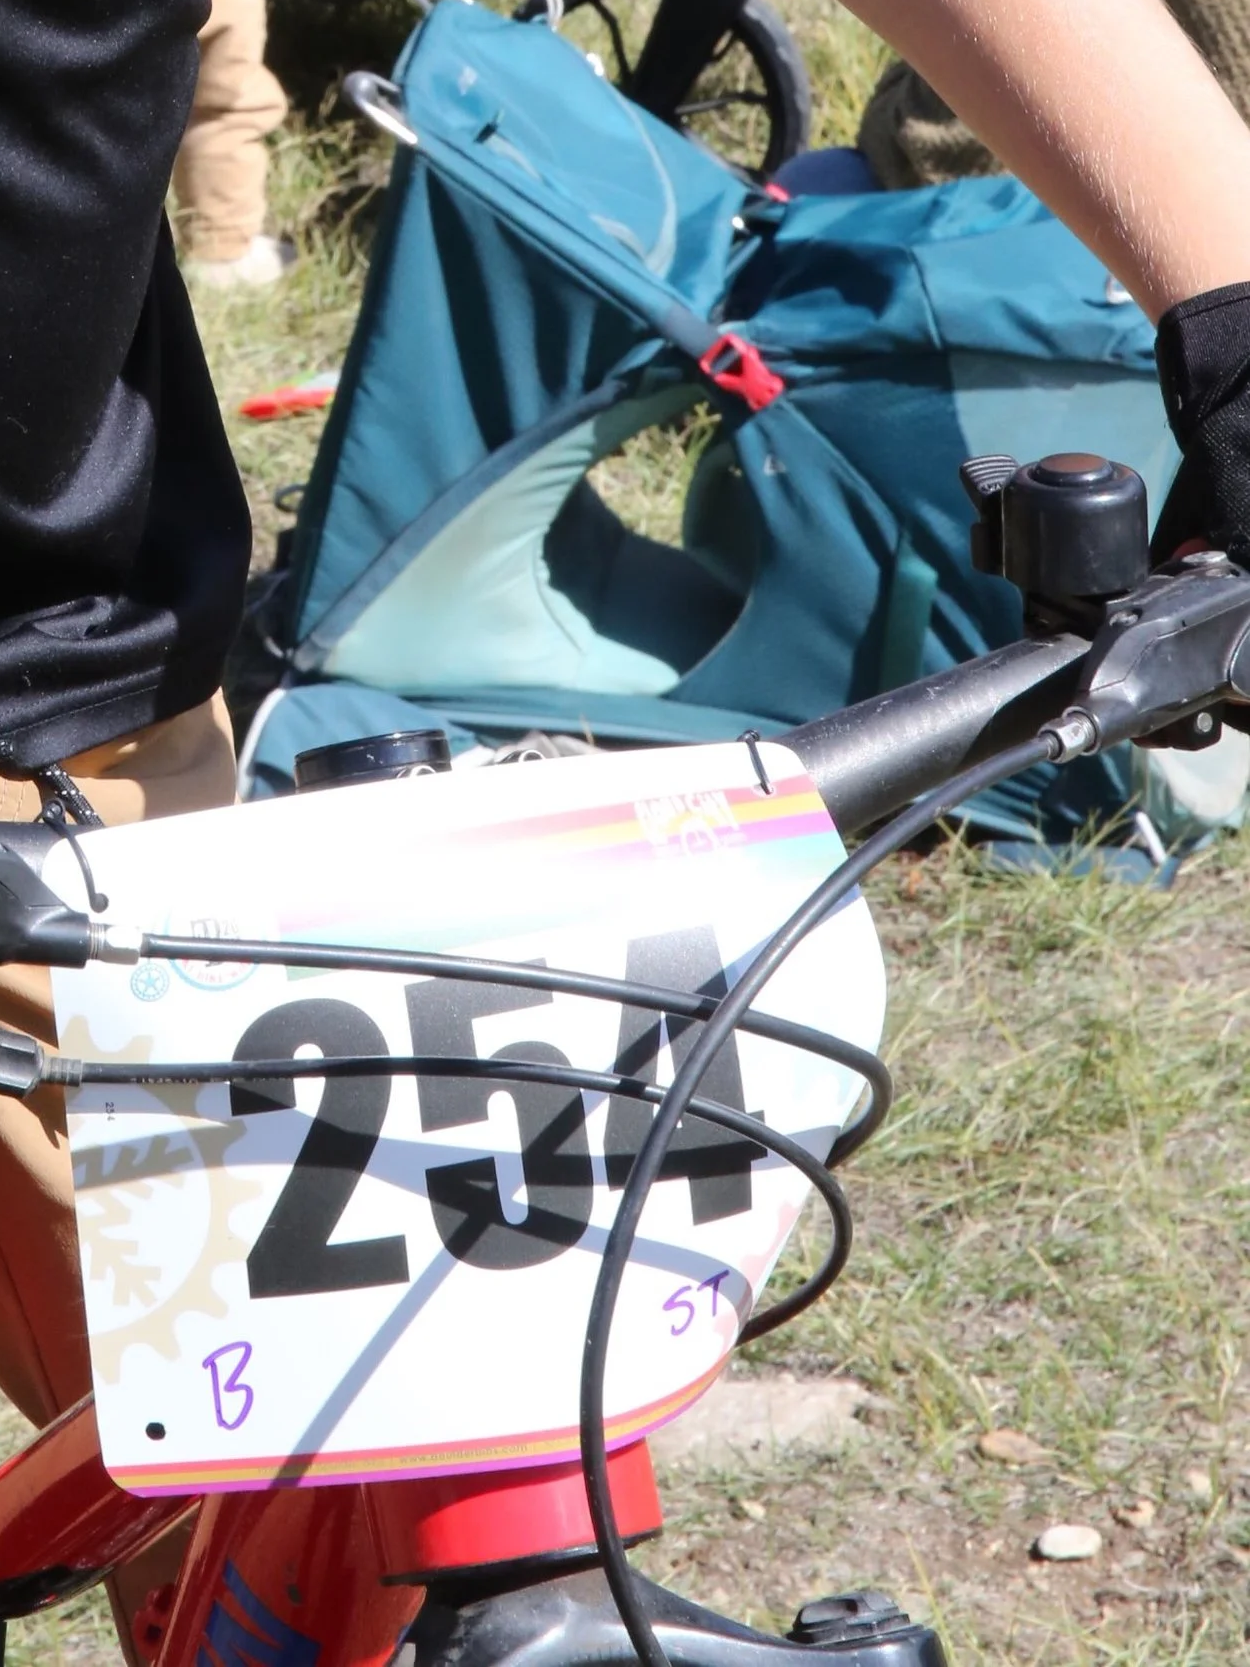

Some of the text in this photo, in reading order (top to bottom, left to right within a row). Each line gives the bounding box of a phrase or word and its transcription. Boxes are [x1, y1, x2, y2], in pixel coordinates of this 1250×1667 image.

[230, 924, 768, 1300] 254
[662, 1269, 730, 1336] ST
[202, 1341, 254, 1430] B
